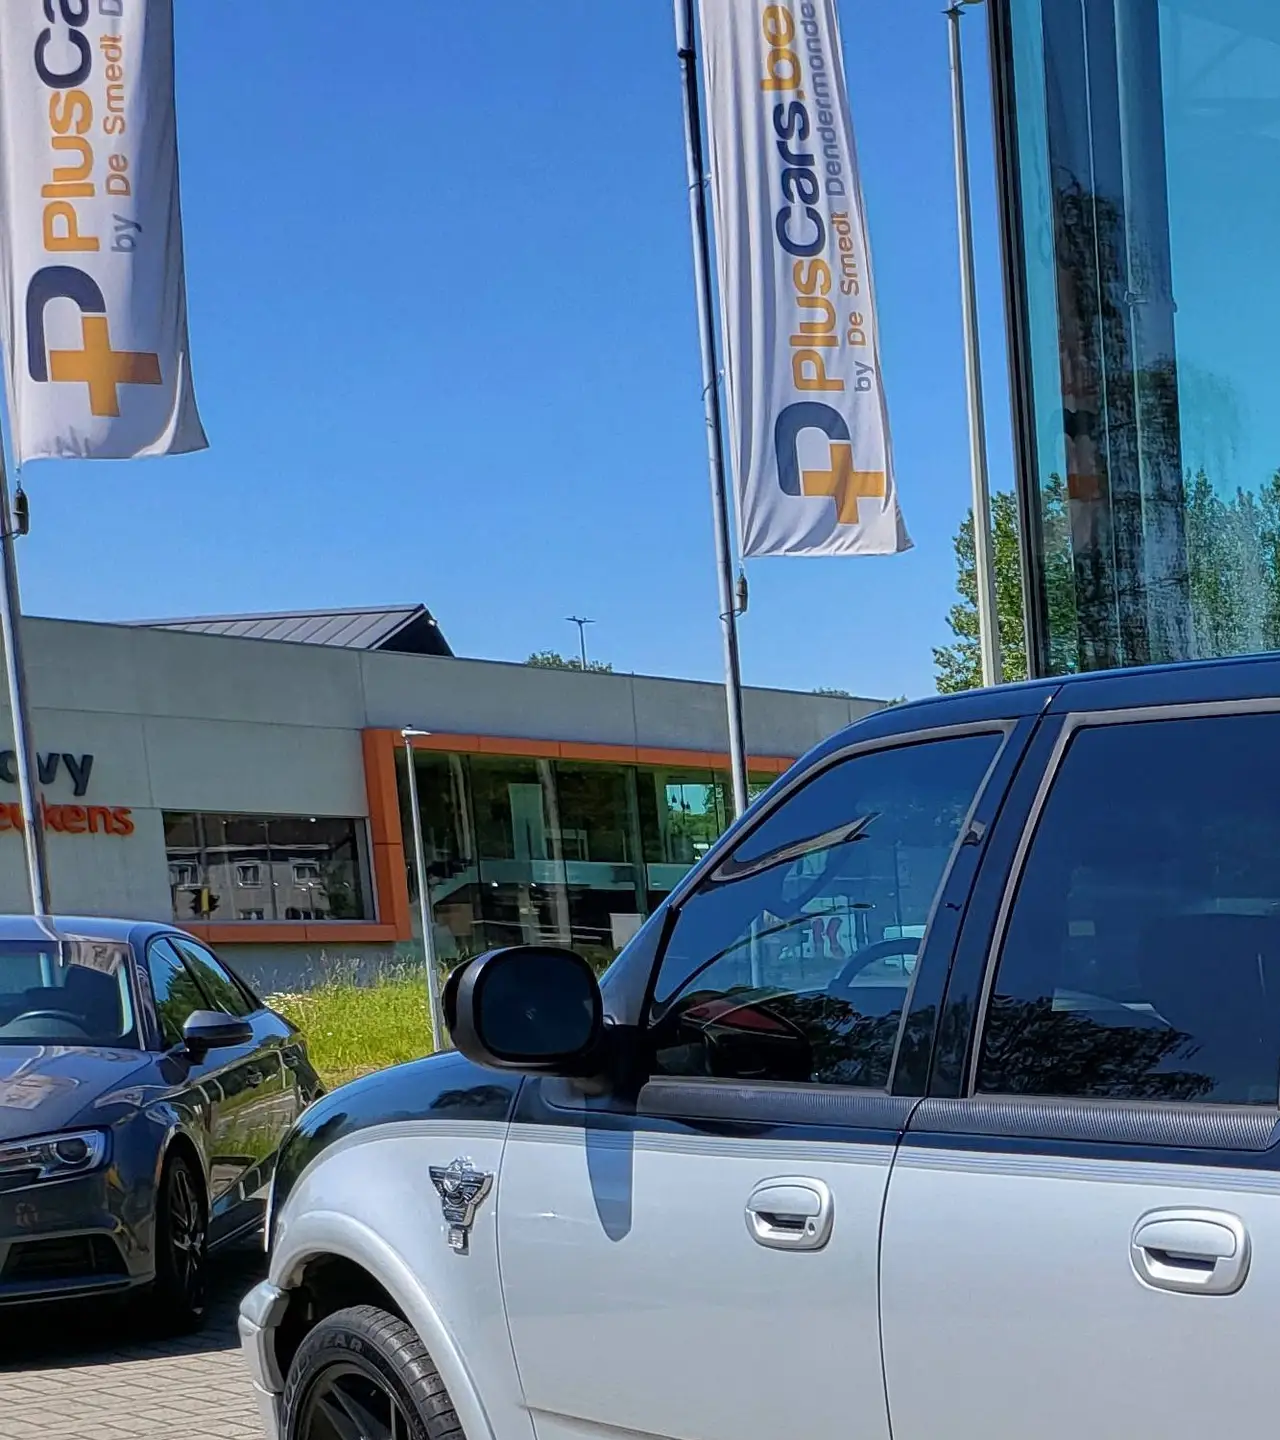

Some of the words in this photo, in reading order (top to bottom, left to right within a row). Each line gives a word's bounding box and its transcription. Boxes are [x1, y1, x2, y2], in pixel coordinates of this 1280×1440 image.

[99, 33, 126, 135] Smedt
[799, 0, 847, 197] Dendermonde
[106, 153, 132, 198] De
[759, 4, 846, 393] PlusCars.be
[111, 213, 142, 254] by
[831, 211, 860, 296] Smedt
[848, 311, 866, 346] De
[854, 360, 875, 393] by
